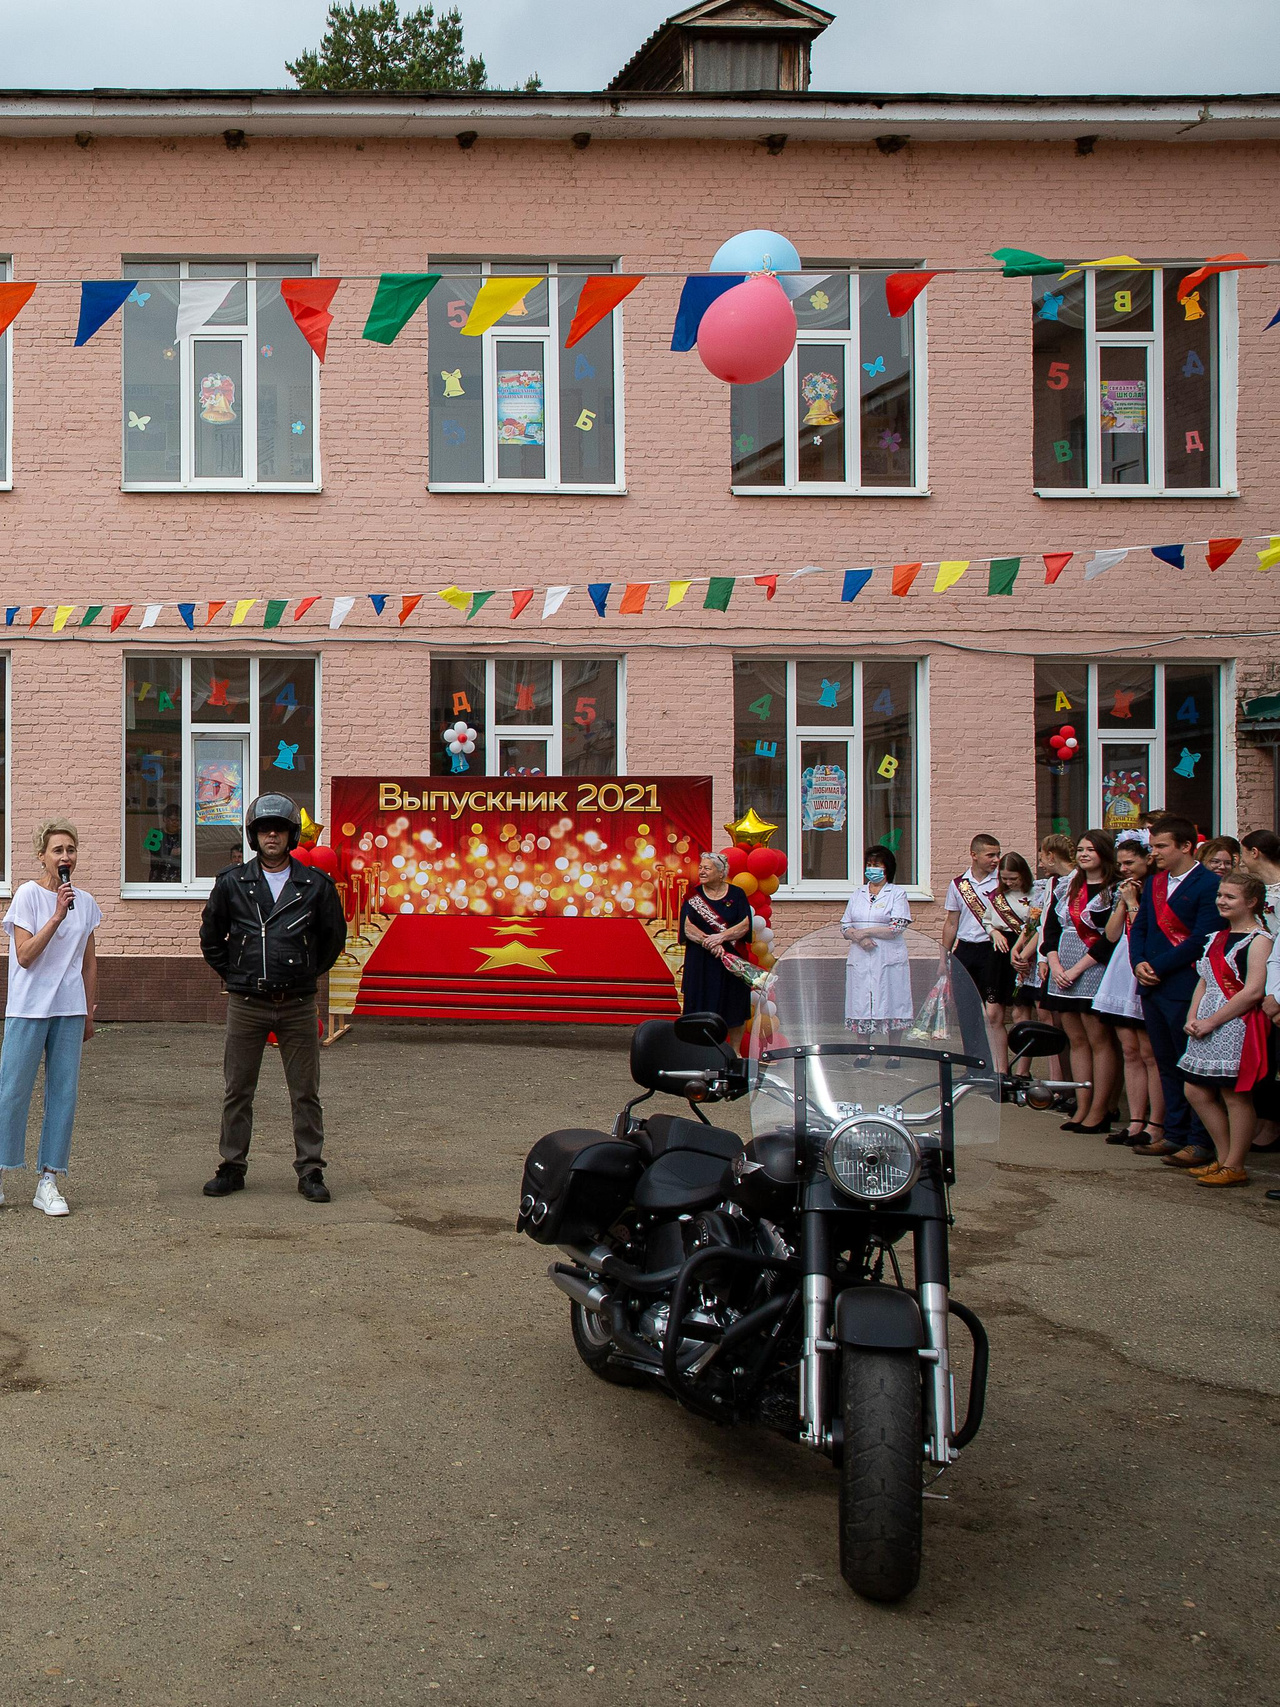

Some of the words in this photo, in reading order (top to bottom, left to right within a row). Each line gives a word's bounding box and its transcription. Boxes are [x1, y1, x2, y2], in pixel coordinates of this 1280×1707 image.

[447, 300, 468, 328] 5
[1046, 362, 1070, 390] 5
[574, 408, 597, 432] Б
[1053, 440, 1073, 463] В
[1185, 430, 1205, 453] Д
[158, 691, 175, 713] А
[275, 683, 298, 711] 4
[452, 691, 472, 716] Д
[748, 693, 773, 721] 4
[872, 688, 895, 716] 4
[1055, 690, 1072, 712] А
[1176, 696, 1200, 724] 4
[573, 697, 597, 726] 5
[141, 754, 164, 781] 5
[877, 754, 899, 779] В
[378, 783, 568, 819] Выпускник
[576, 784, 662, 812] 2021
[143, 827, 164, 852] В
[879, 827, 903, 854] 4
